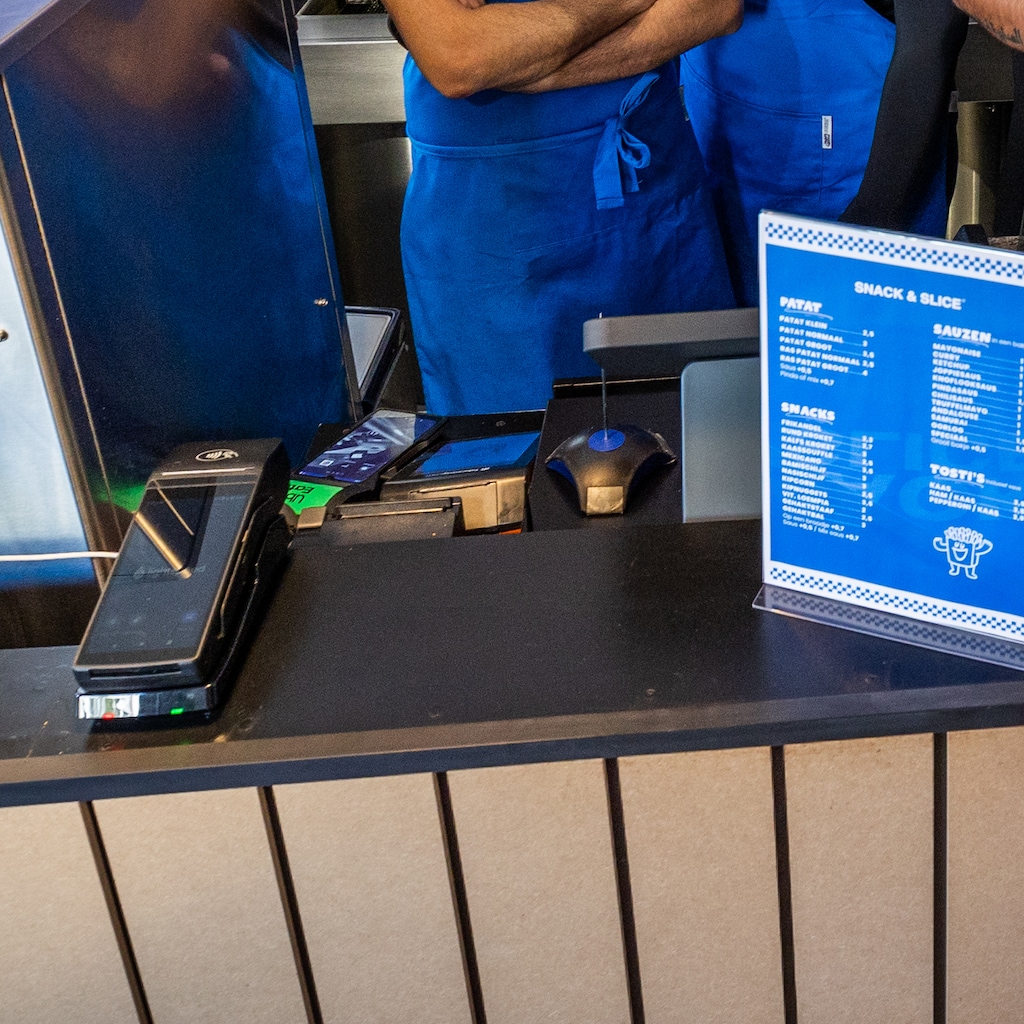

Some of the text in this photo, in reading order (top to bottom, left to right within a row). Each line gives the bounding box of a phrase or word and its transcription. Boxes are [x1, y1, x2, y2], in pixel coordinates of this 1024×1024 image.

[854, 281, 904, 300] SNACK
[907, 290, 917, 302] &
[780, 296, 822, 312] PATAT
[779, 315, 828, 330] PATAT KLEIN
[779, 326, 844, 343] PATAT NORMAAL
[933, 324, 991, 343] SAUZEN
[781, 402, 835, 421] SNACKS
[930, 463, 985, 483] TOSTI'S
